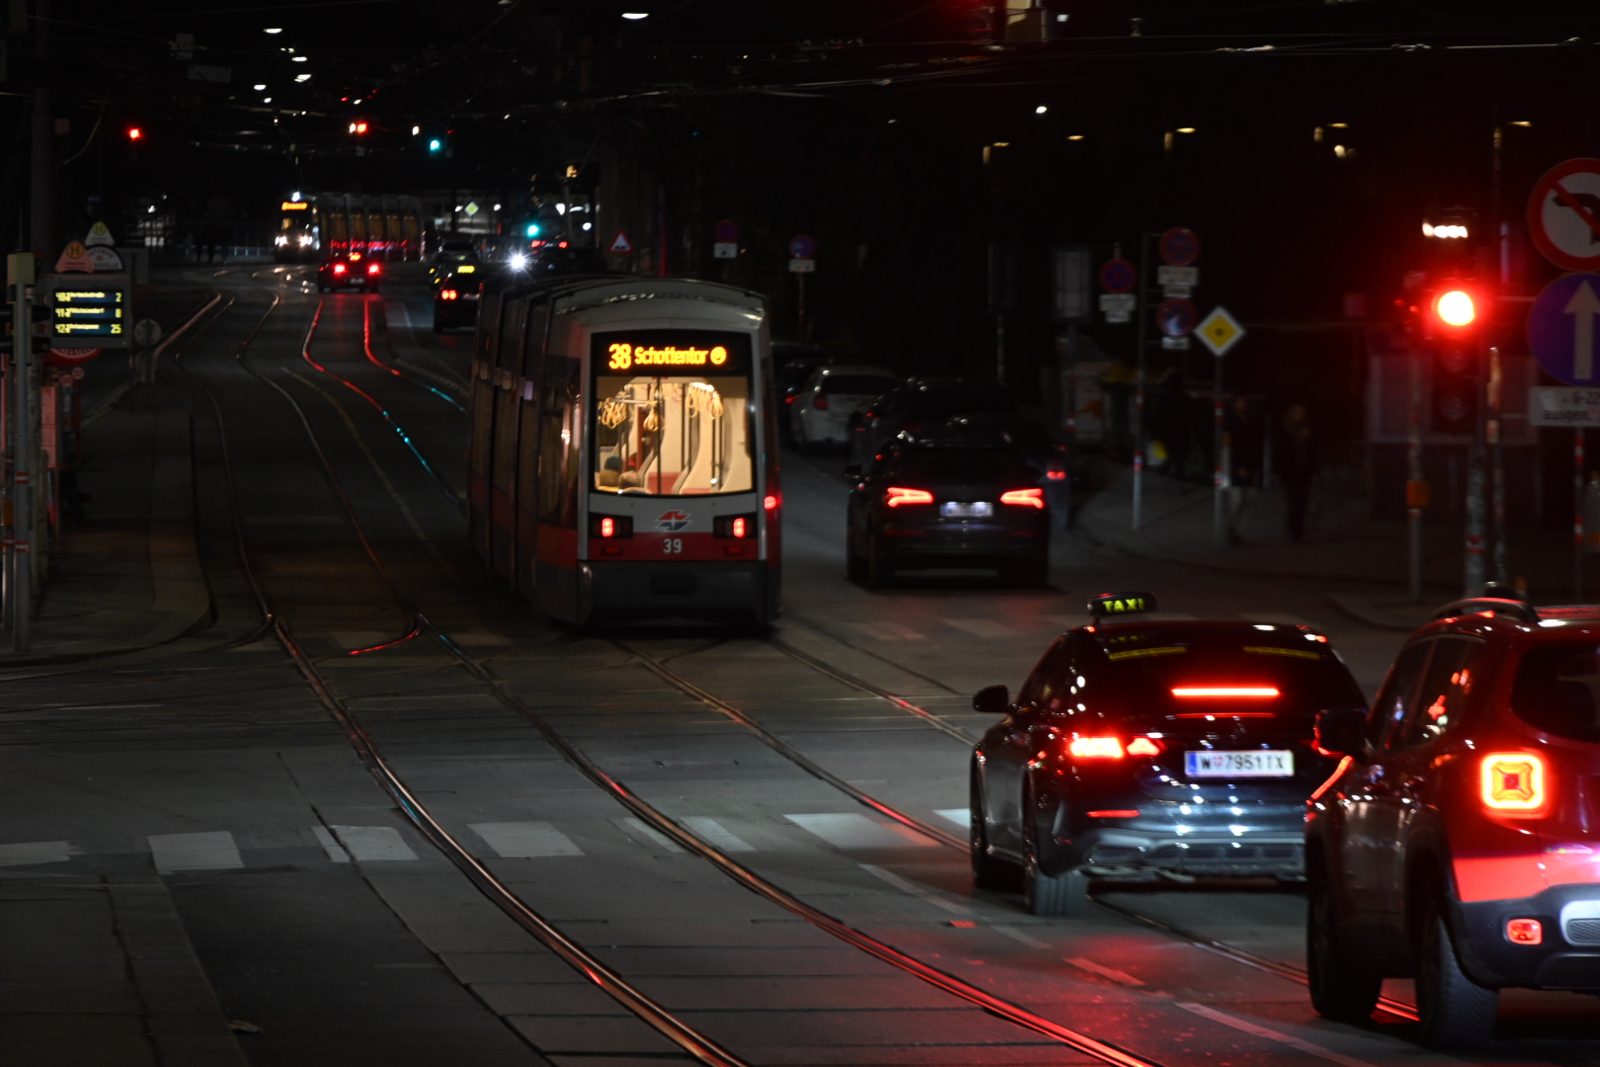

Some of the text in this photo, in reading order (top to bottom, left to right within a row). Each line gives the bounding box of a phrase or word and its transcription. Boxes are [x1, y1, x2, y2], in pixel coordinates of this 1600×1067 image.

[116, 293, 122, 302] 2
[110, 324, 122, 334] 25
[608, 343, 632, 370] 38
[634, 346, 709, 365] Schottentor
[663, 538, 683, 554] 39
[1103, 598, 1144, 612] TAXI
